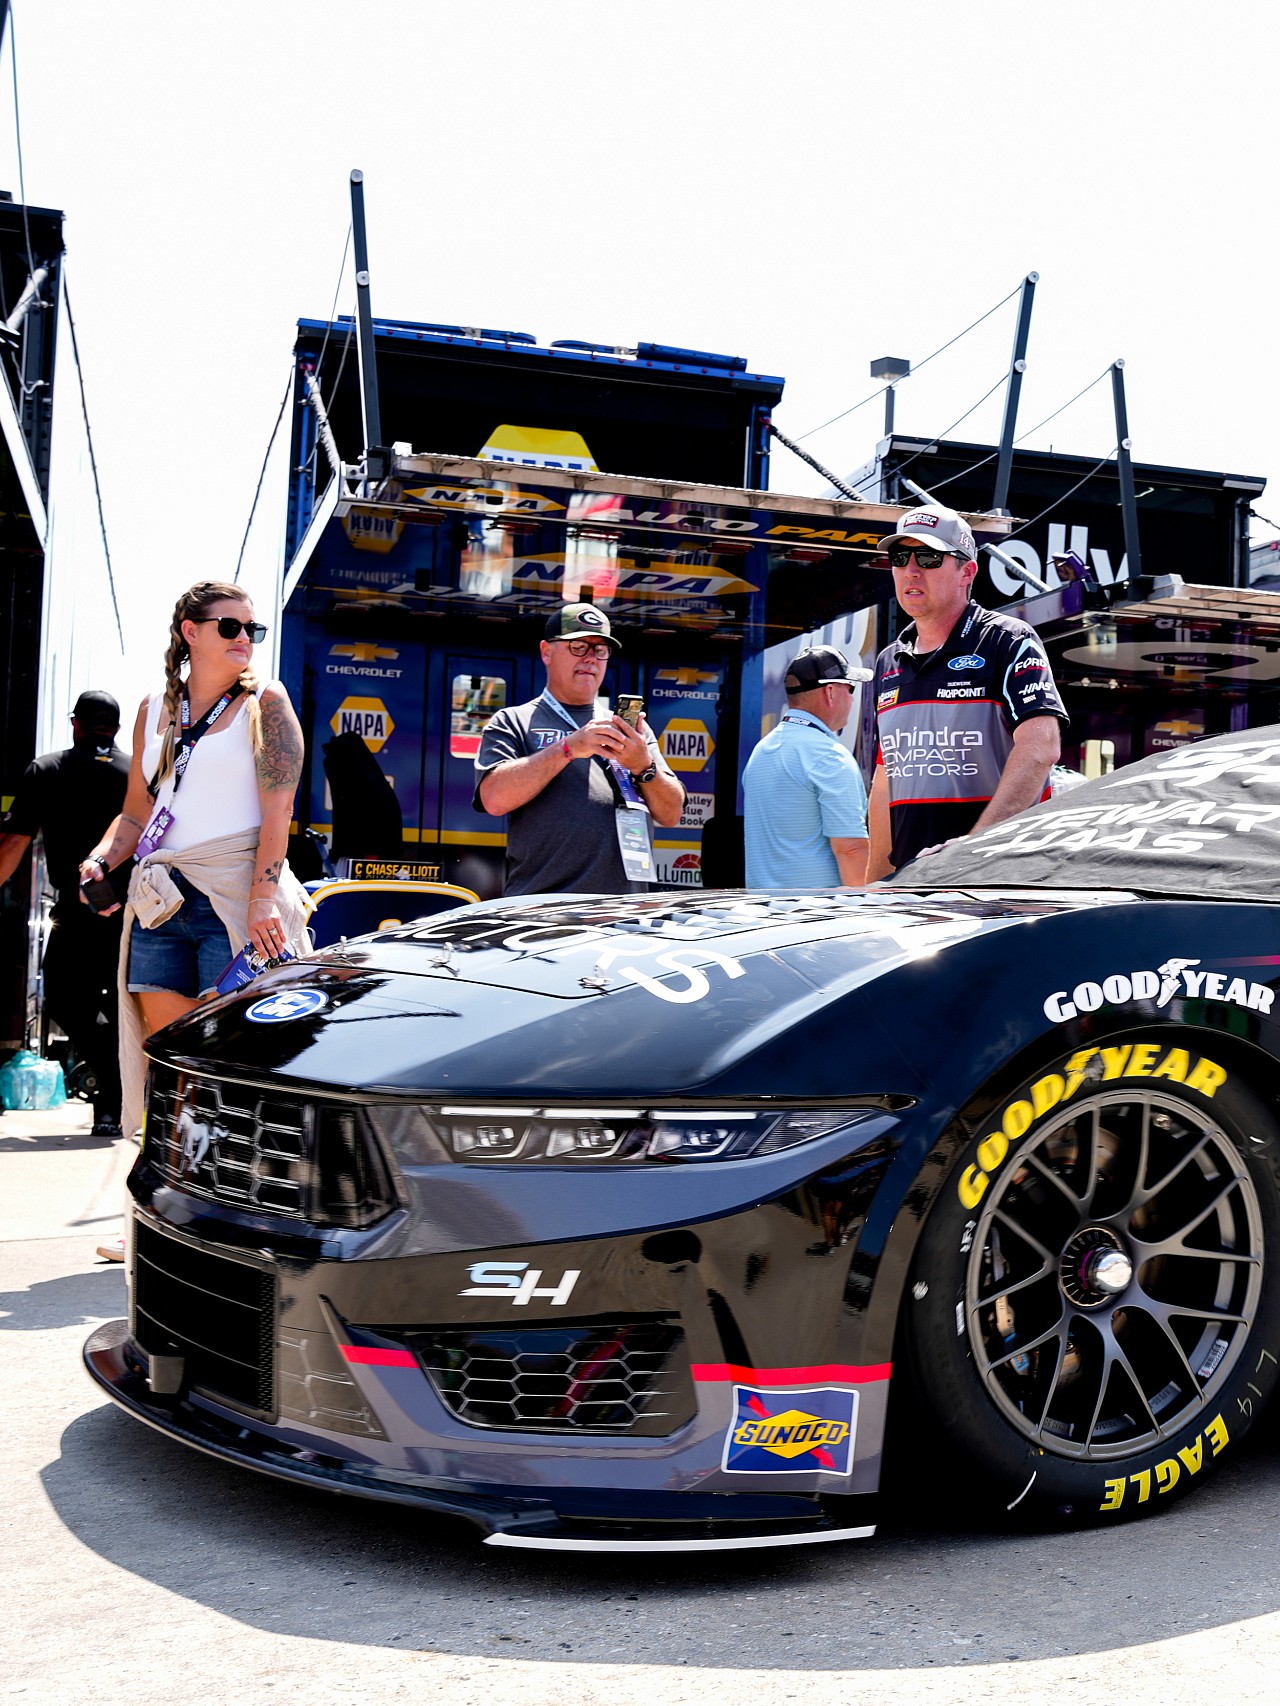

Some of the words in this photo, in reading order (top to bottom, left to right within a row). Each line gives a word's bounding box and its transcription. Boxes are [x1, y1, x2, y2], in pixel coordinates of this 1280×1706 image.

[431, 490, 539, 510] NAA
[764, 525, 886, 544] PAR
[325, 665, 403, 678] CHEVROLET
[1014, 656, 1048, 673] FORD
[652, 688, 721, 701] CHEVROLET
[1018, 682, 1053, 696] HAAS
[341, 711, 384, 738] NAPA
[667, 733, 706, 757] NAPA
[881, 726, 983, 752] ahindra
[882, 748, 971, 766] OMPACT
[688, 797, 712, 807] elley
[971, 827, 1229, 858] HAAS
[354, 863, 363, 875] C
[365, 864, 399, 876] CHASE
[401, 865, 440, 877] ELLIOTT
[1043, 957, 1275, 1023] GOODYEAR
[957, 1043, 1228, 1211] GOODYEAR
[737, 1421, 842, 1445] SUNOCO
[1099, 1412, 1230, 1511] EAGLE
